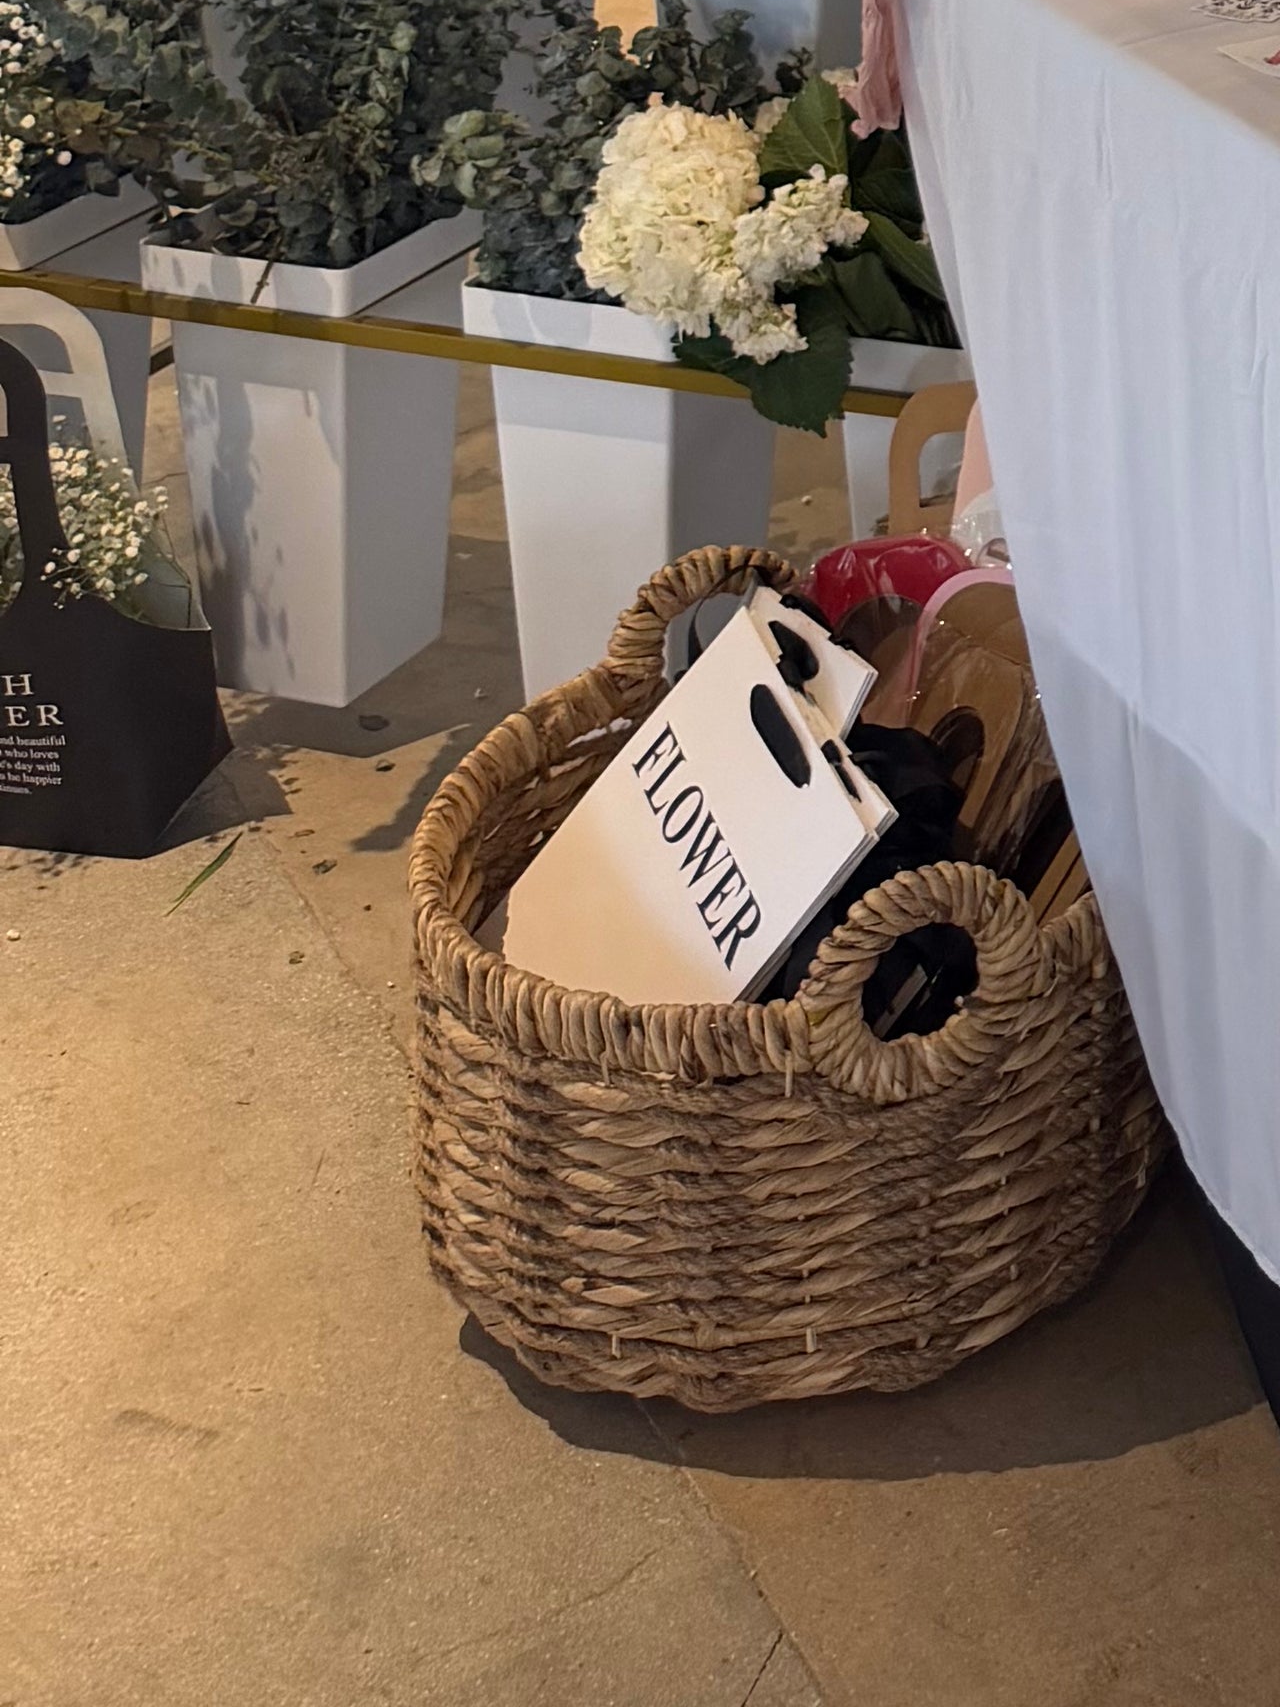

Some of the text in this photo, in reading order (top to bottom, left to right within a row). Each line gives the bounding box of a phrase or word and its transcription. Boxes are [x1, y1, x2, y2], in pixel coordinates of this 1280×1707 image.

[16, 734, 66, 746] beautiful
[4, 748, 60, 759] who loves
[14, 761, 33, 773] day
[36, 761, 60, 772] with
[631, 721, 763, 971] FLOWER
